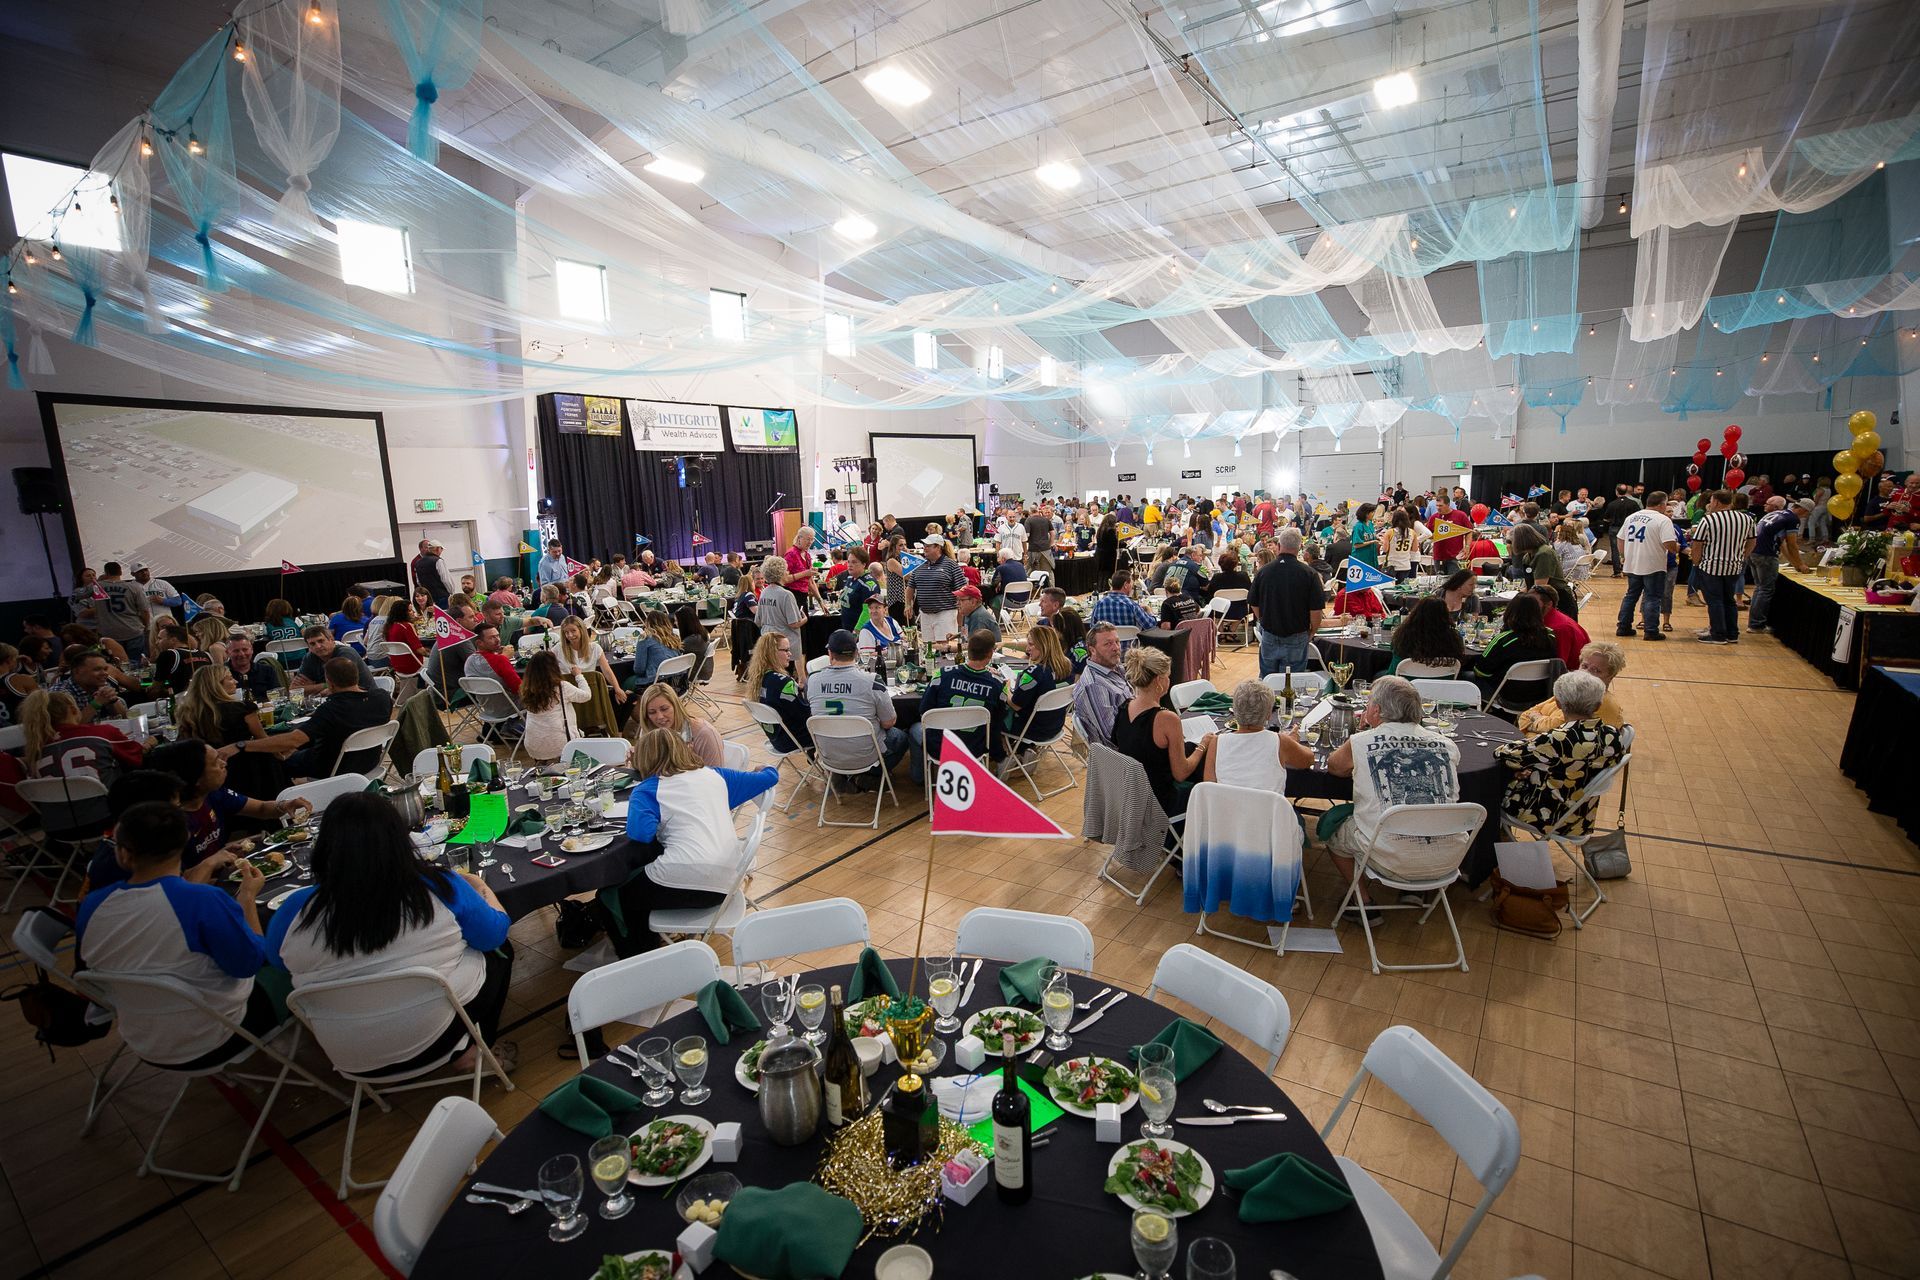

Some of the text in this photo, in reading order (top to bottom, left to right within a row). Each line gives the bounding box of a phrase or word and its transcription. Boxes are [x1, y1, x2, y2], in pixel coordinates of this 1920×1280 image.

[658, 412, 719, 427] INTEGRITY
[661, 430, 718, 439] Wealth Advisors
[1215, 465, 1236, 474] SCRIP
[1035, 477, 1054, 491] Beer
[1438, 525, 1449, 533] 38
[1627, 525, 1646, 543] 24
[1395, 540, 1410, 552] 35
[1349, 568, 1362, 579] 37
[437, 620, 449, 634] 35
[271, 627, 297, 640] 22
[820, 682, 852, 694] WILSON
[950, 678, 993, 697] LOCKETT
[1366, 741, 1447, 752] DAVIDSON
[939, 769, 970, 803] 36
